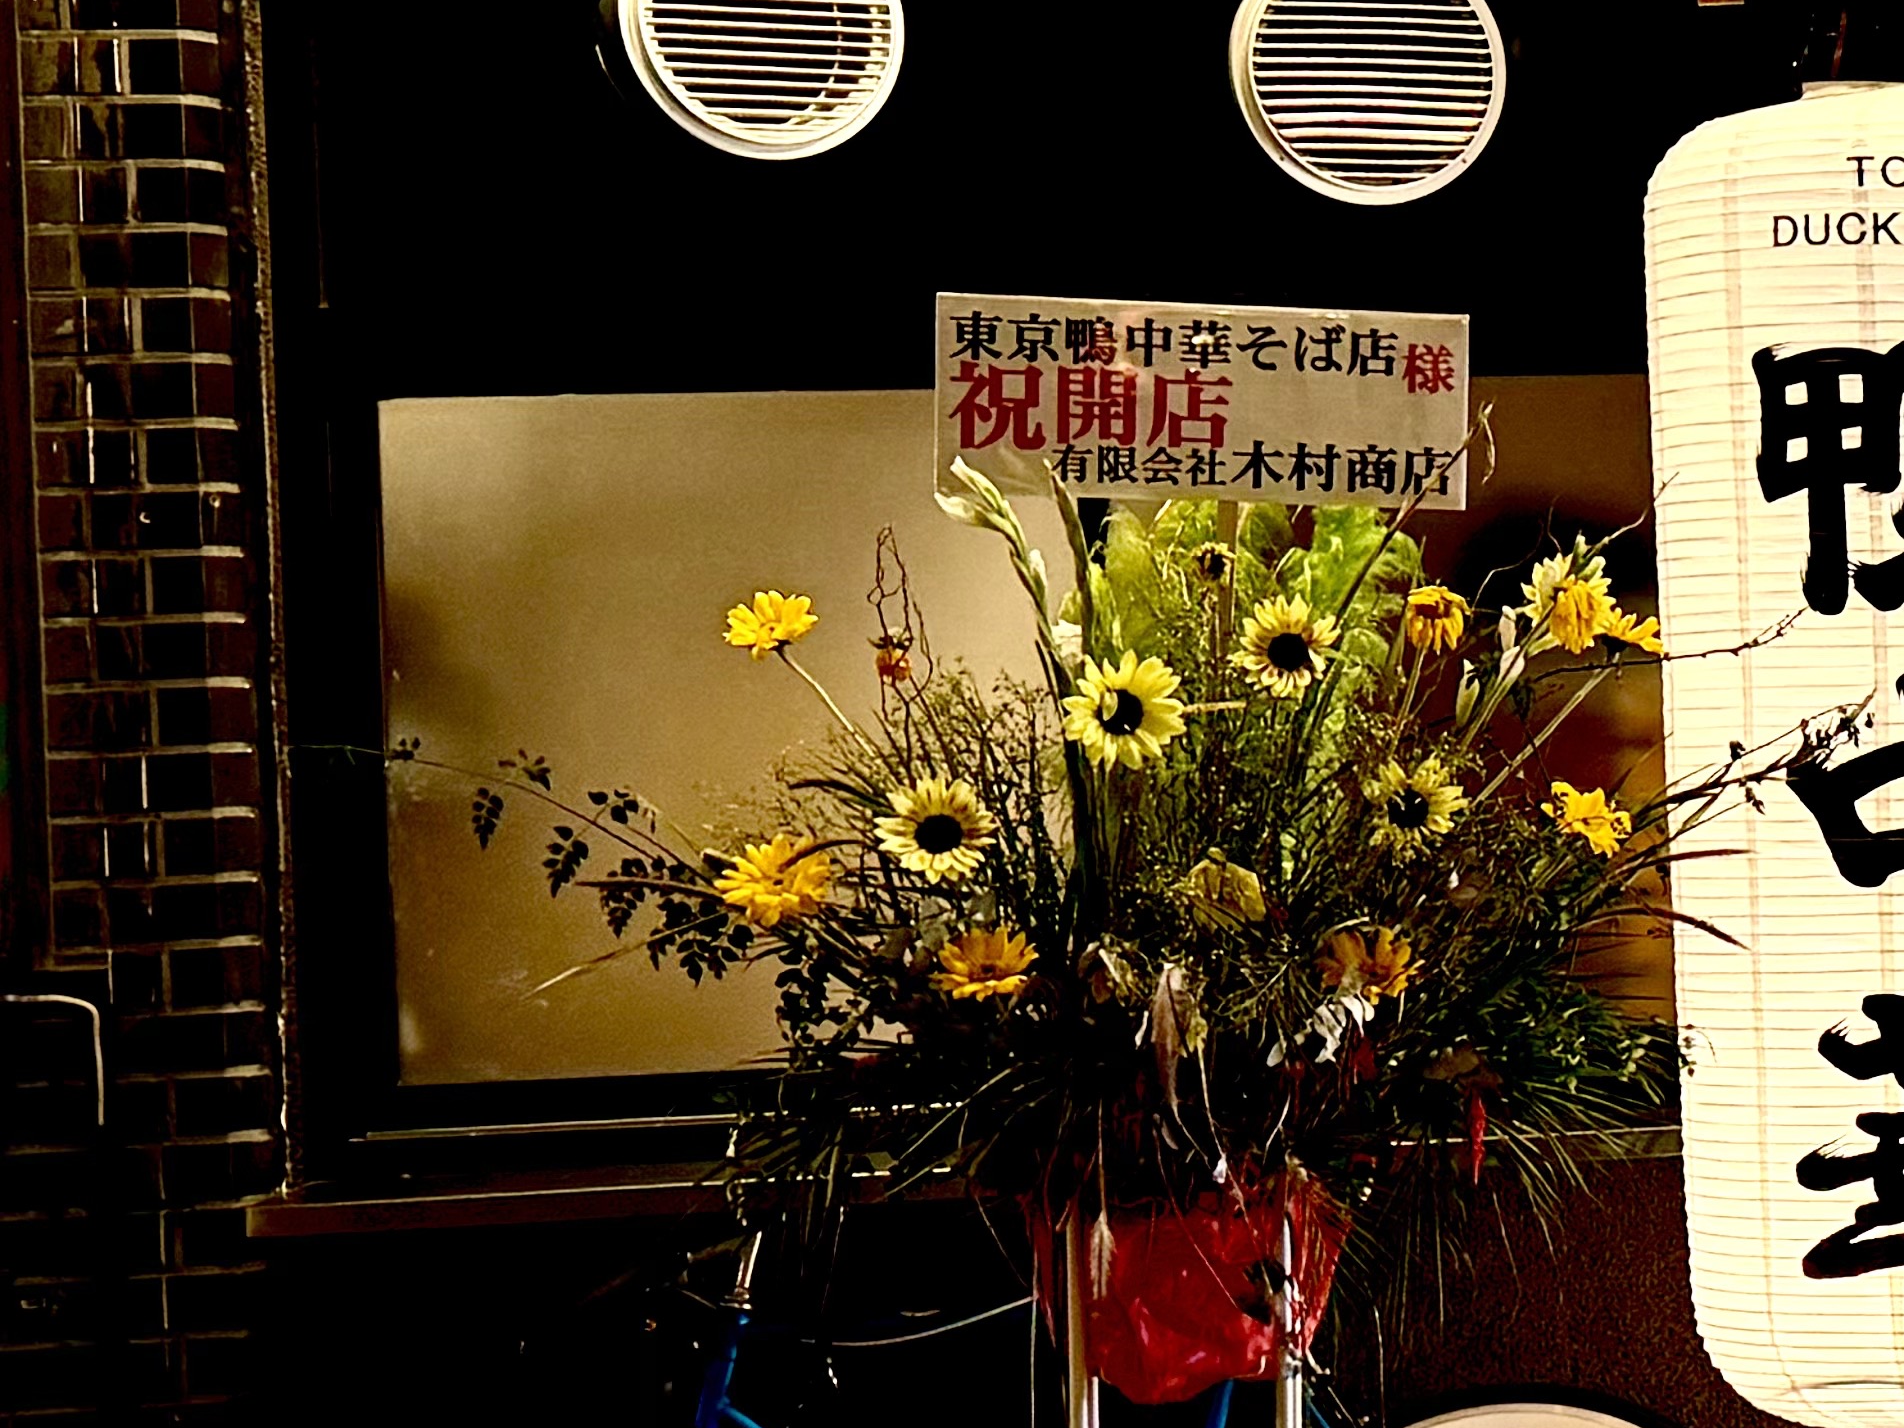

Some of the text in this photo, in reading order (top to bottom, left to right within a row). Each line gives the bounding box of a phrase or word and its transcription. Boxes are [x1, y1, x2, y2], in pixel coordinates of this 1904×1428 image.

[1772, 212, 1902, 248] DUCK
[949, 360, 1234, 452] 祝開店
[1052, 440, 1453, 496] 有限会社木村商店
